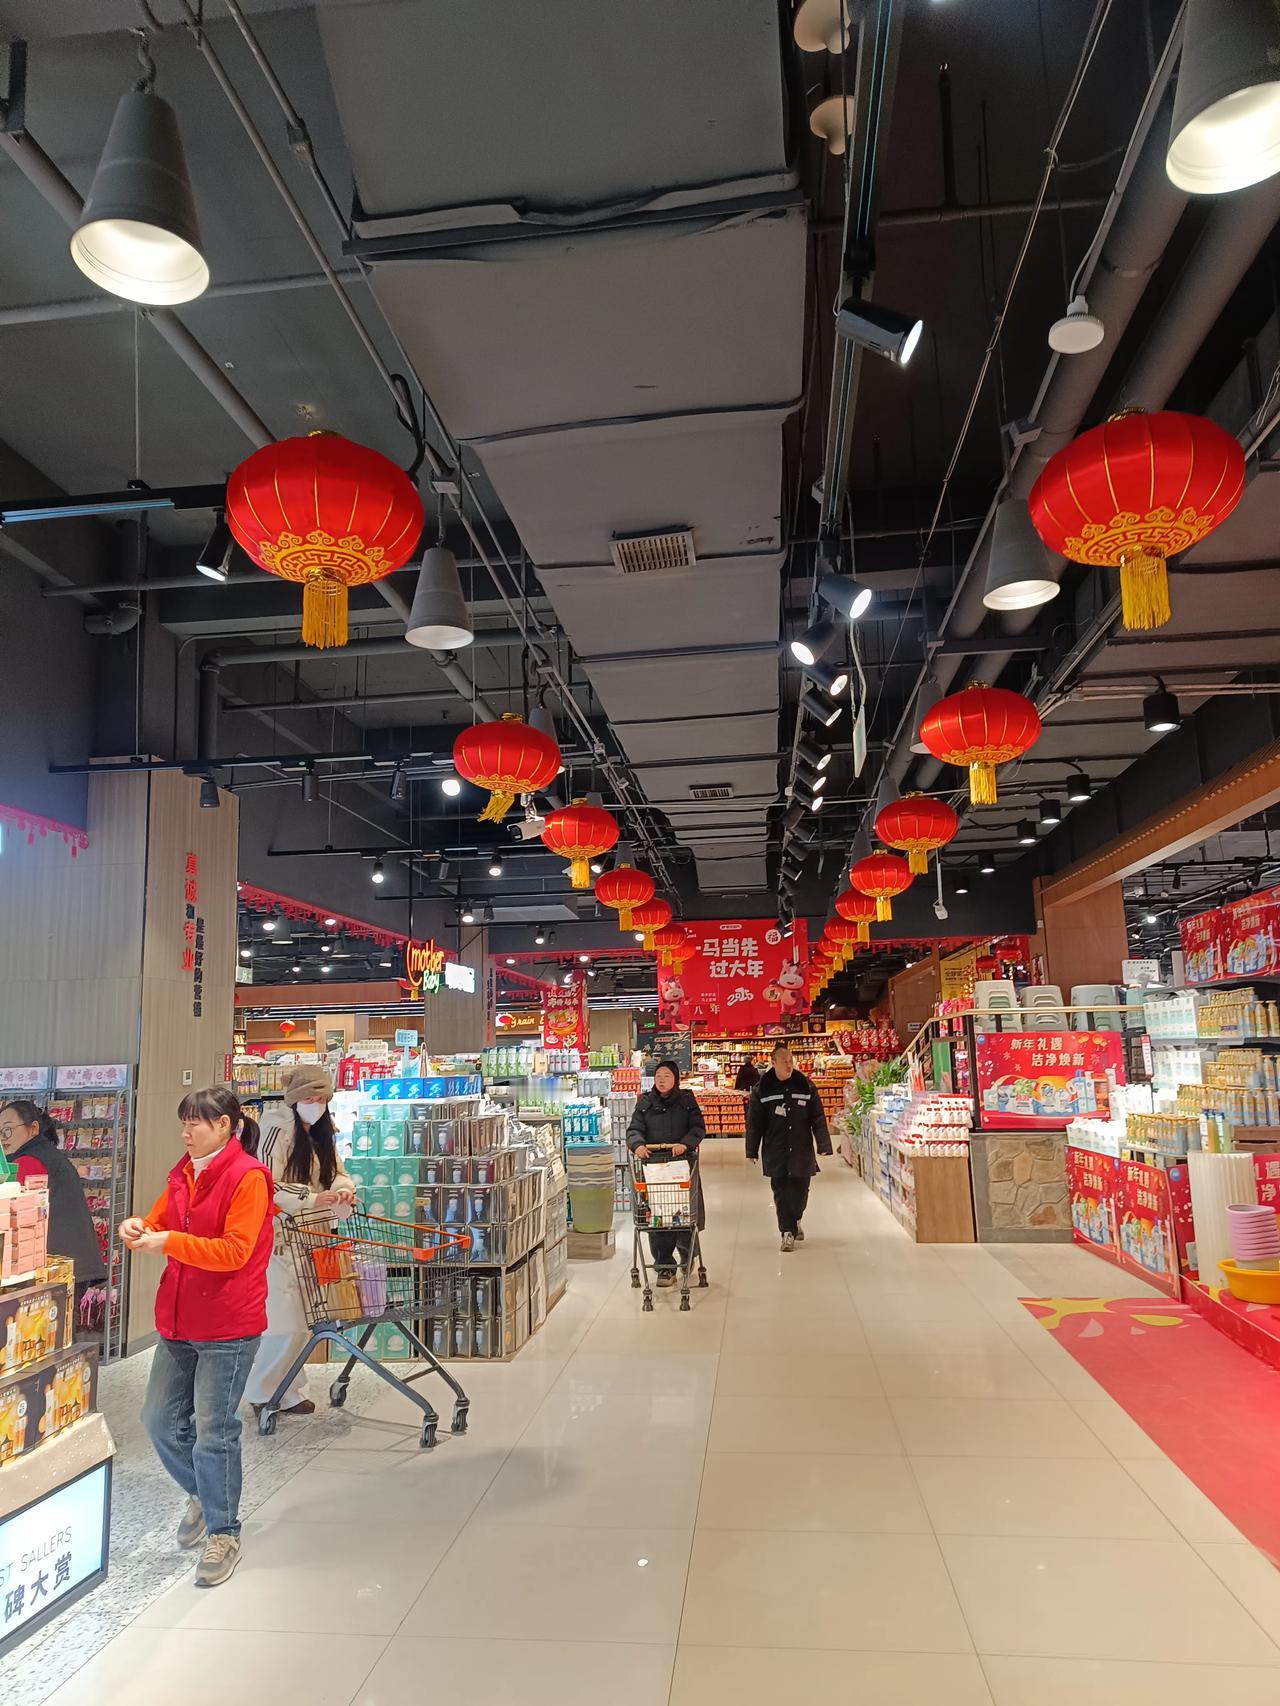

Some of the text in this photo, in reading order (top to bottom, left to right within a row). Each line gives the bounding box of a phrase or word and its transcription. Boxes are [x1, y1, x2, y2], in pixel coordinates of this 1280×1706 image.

[696, 937, 758, 957] 马当先
[709, 959, 764, 978] 过大年
[423, 969, 440, 994] Baby
[1010, 1037, 1063, 1051] 新年礼遇
[1031, 1052, 1085, 1067] 洁净焕新
[20, 1525, 72, 1572] SALLERS
